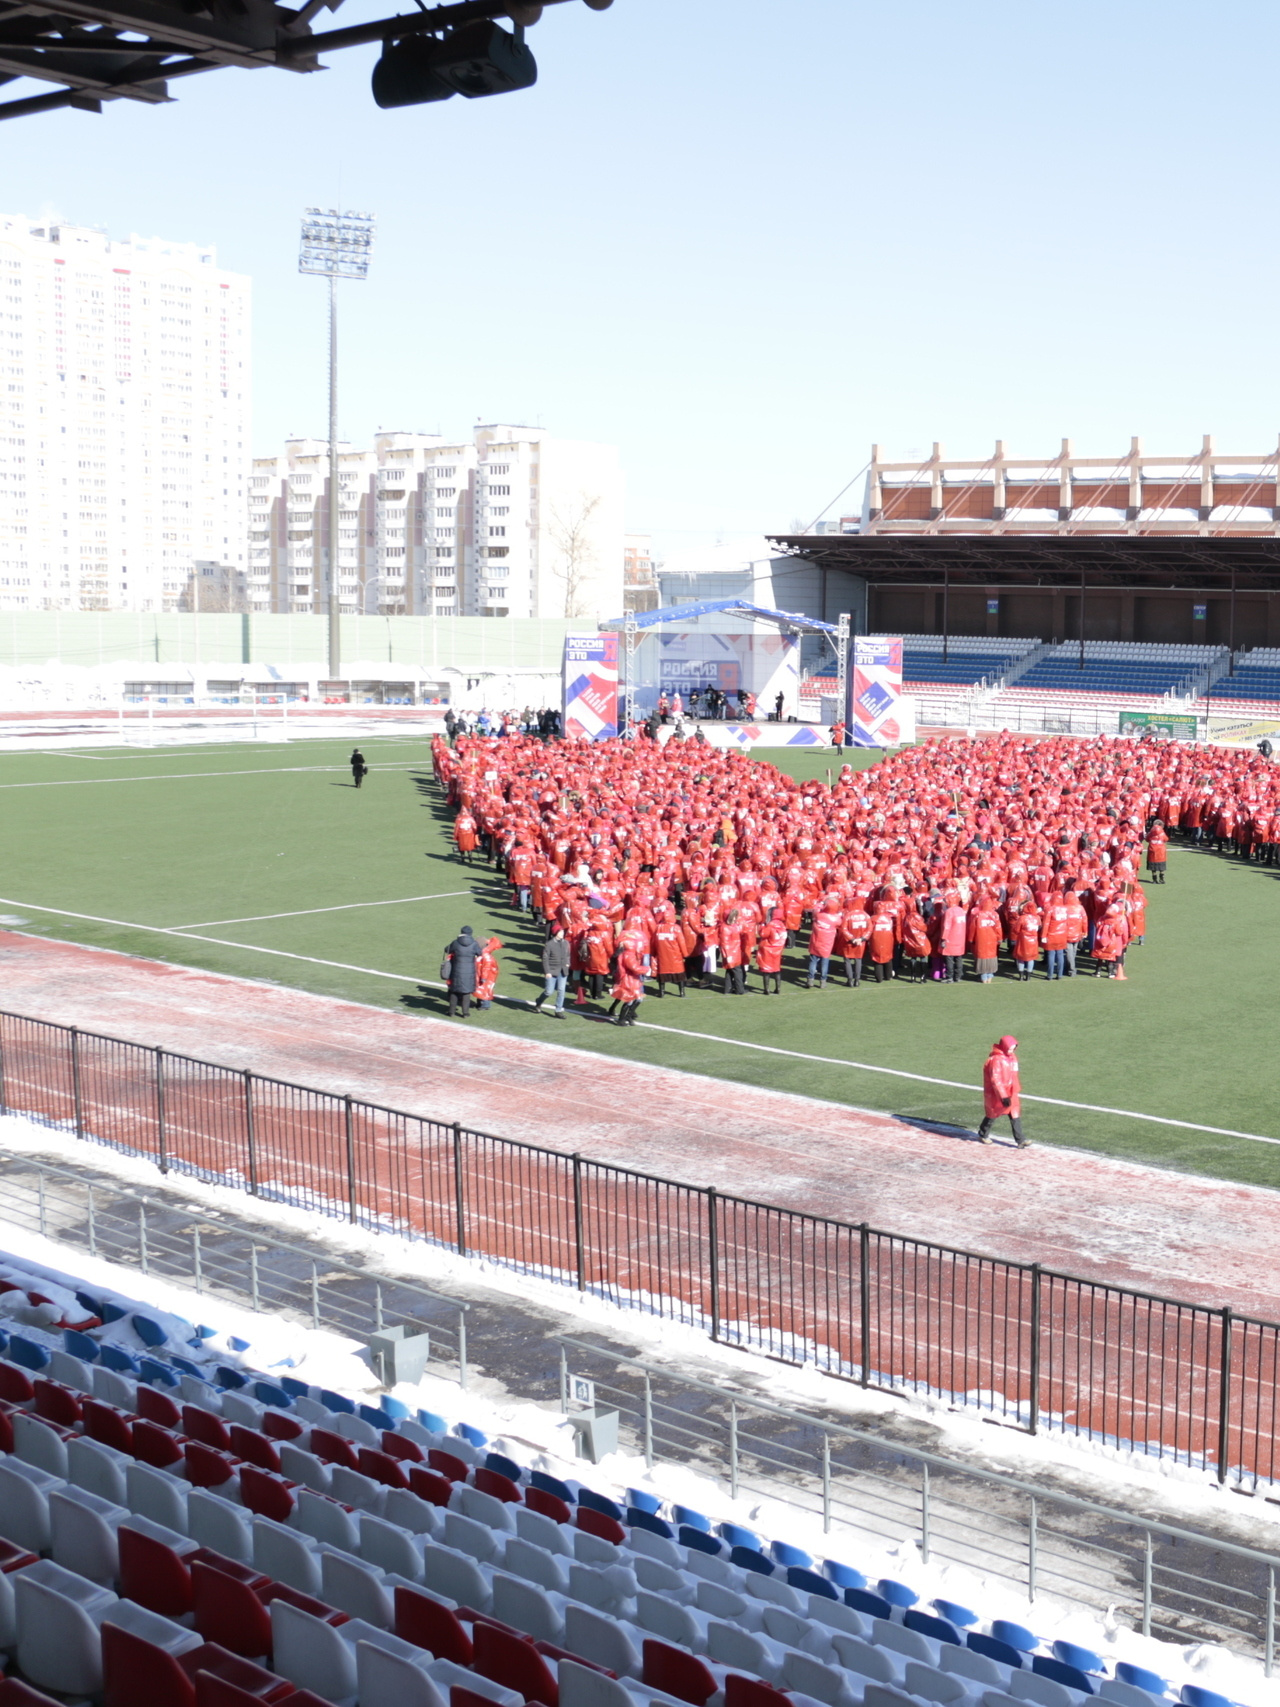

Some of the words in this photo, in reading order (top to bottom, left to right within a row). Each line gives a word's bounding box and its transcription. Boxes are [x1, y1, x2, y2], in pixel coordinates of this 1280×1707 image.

[568, 639, 604, 649] РОССИЯ
[856, 644, 890, 654] РОССИЯ
[603, 640, 617, 660] Я
[889, 645, 901, 664] Я
[568, 652, 588, 660] ЭТО
[856, 656, 874, 664] ЭТО
[663, 662, 718, 676] РОССИЯ
[719, 663, 739, 694] Я
[663, 681, 691, 694] ЭТО
[1226, 722, 1253, 731] кататься
